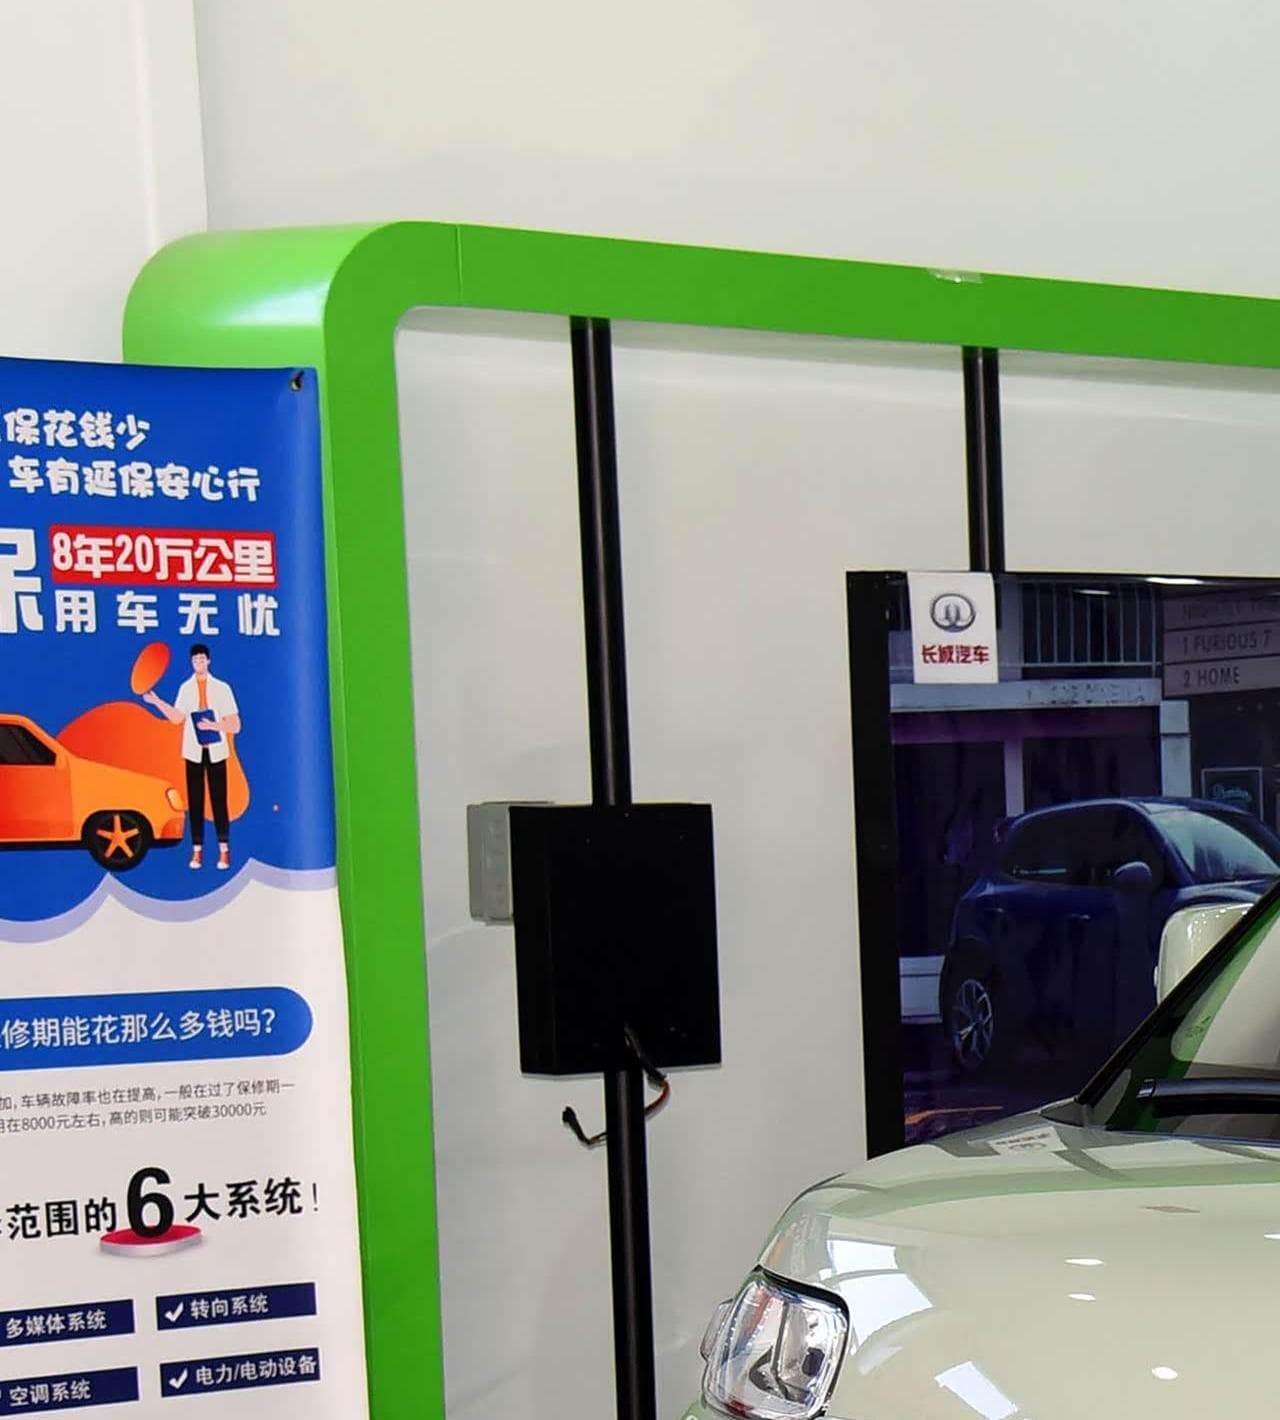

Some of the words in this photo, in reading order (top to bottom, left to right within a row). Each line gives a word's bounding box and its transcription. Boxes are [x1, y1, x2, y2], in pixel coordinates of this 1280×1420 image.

[0, 407, 150, 451] 保花钱少
[8, 455, 260, 502] 车有延保安心行
[53, 532, 275, 583] 8年20万公里
[921, 644, 989, 665] 长城汽车
[1198, 667, 1240, 687] HOME
[0, 1008, 276, 1050] 修期能花那么多钱吗？
[0, 1167, 320, 1241] 范围的6大系统！
[190, 1293, 269, 1320] 转向系统
[6, 1309, 107, 1339] 多媒体系统
[195, 1354, 318, 1386] 电力/电动设备
[9, 1379, 92, 1407] 空调系统
